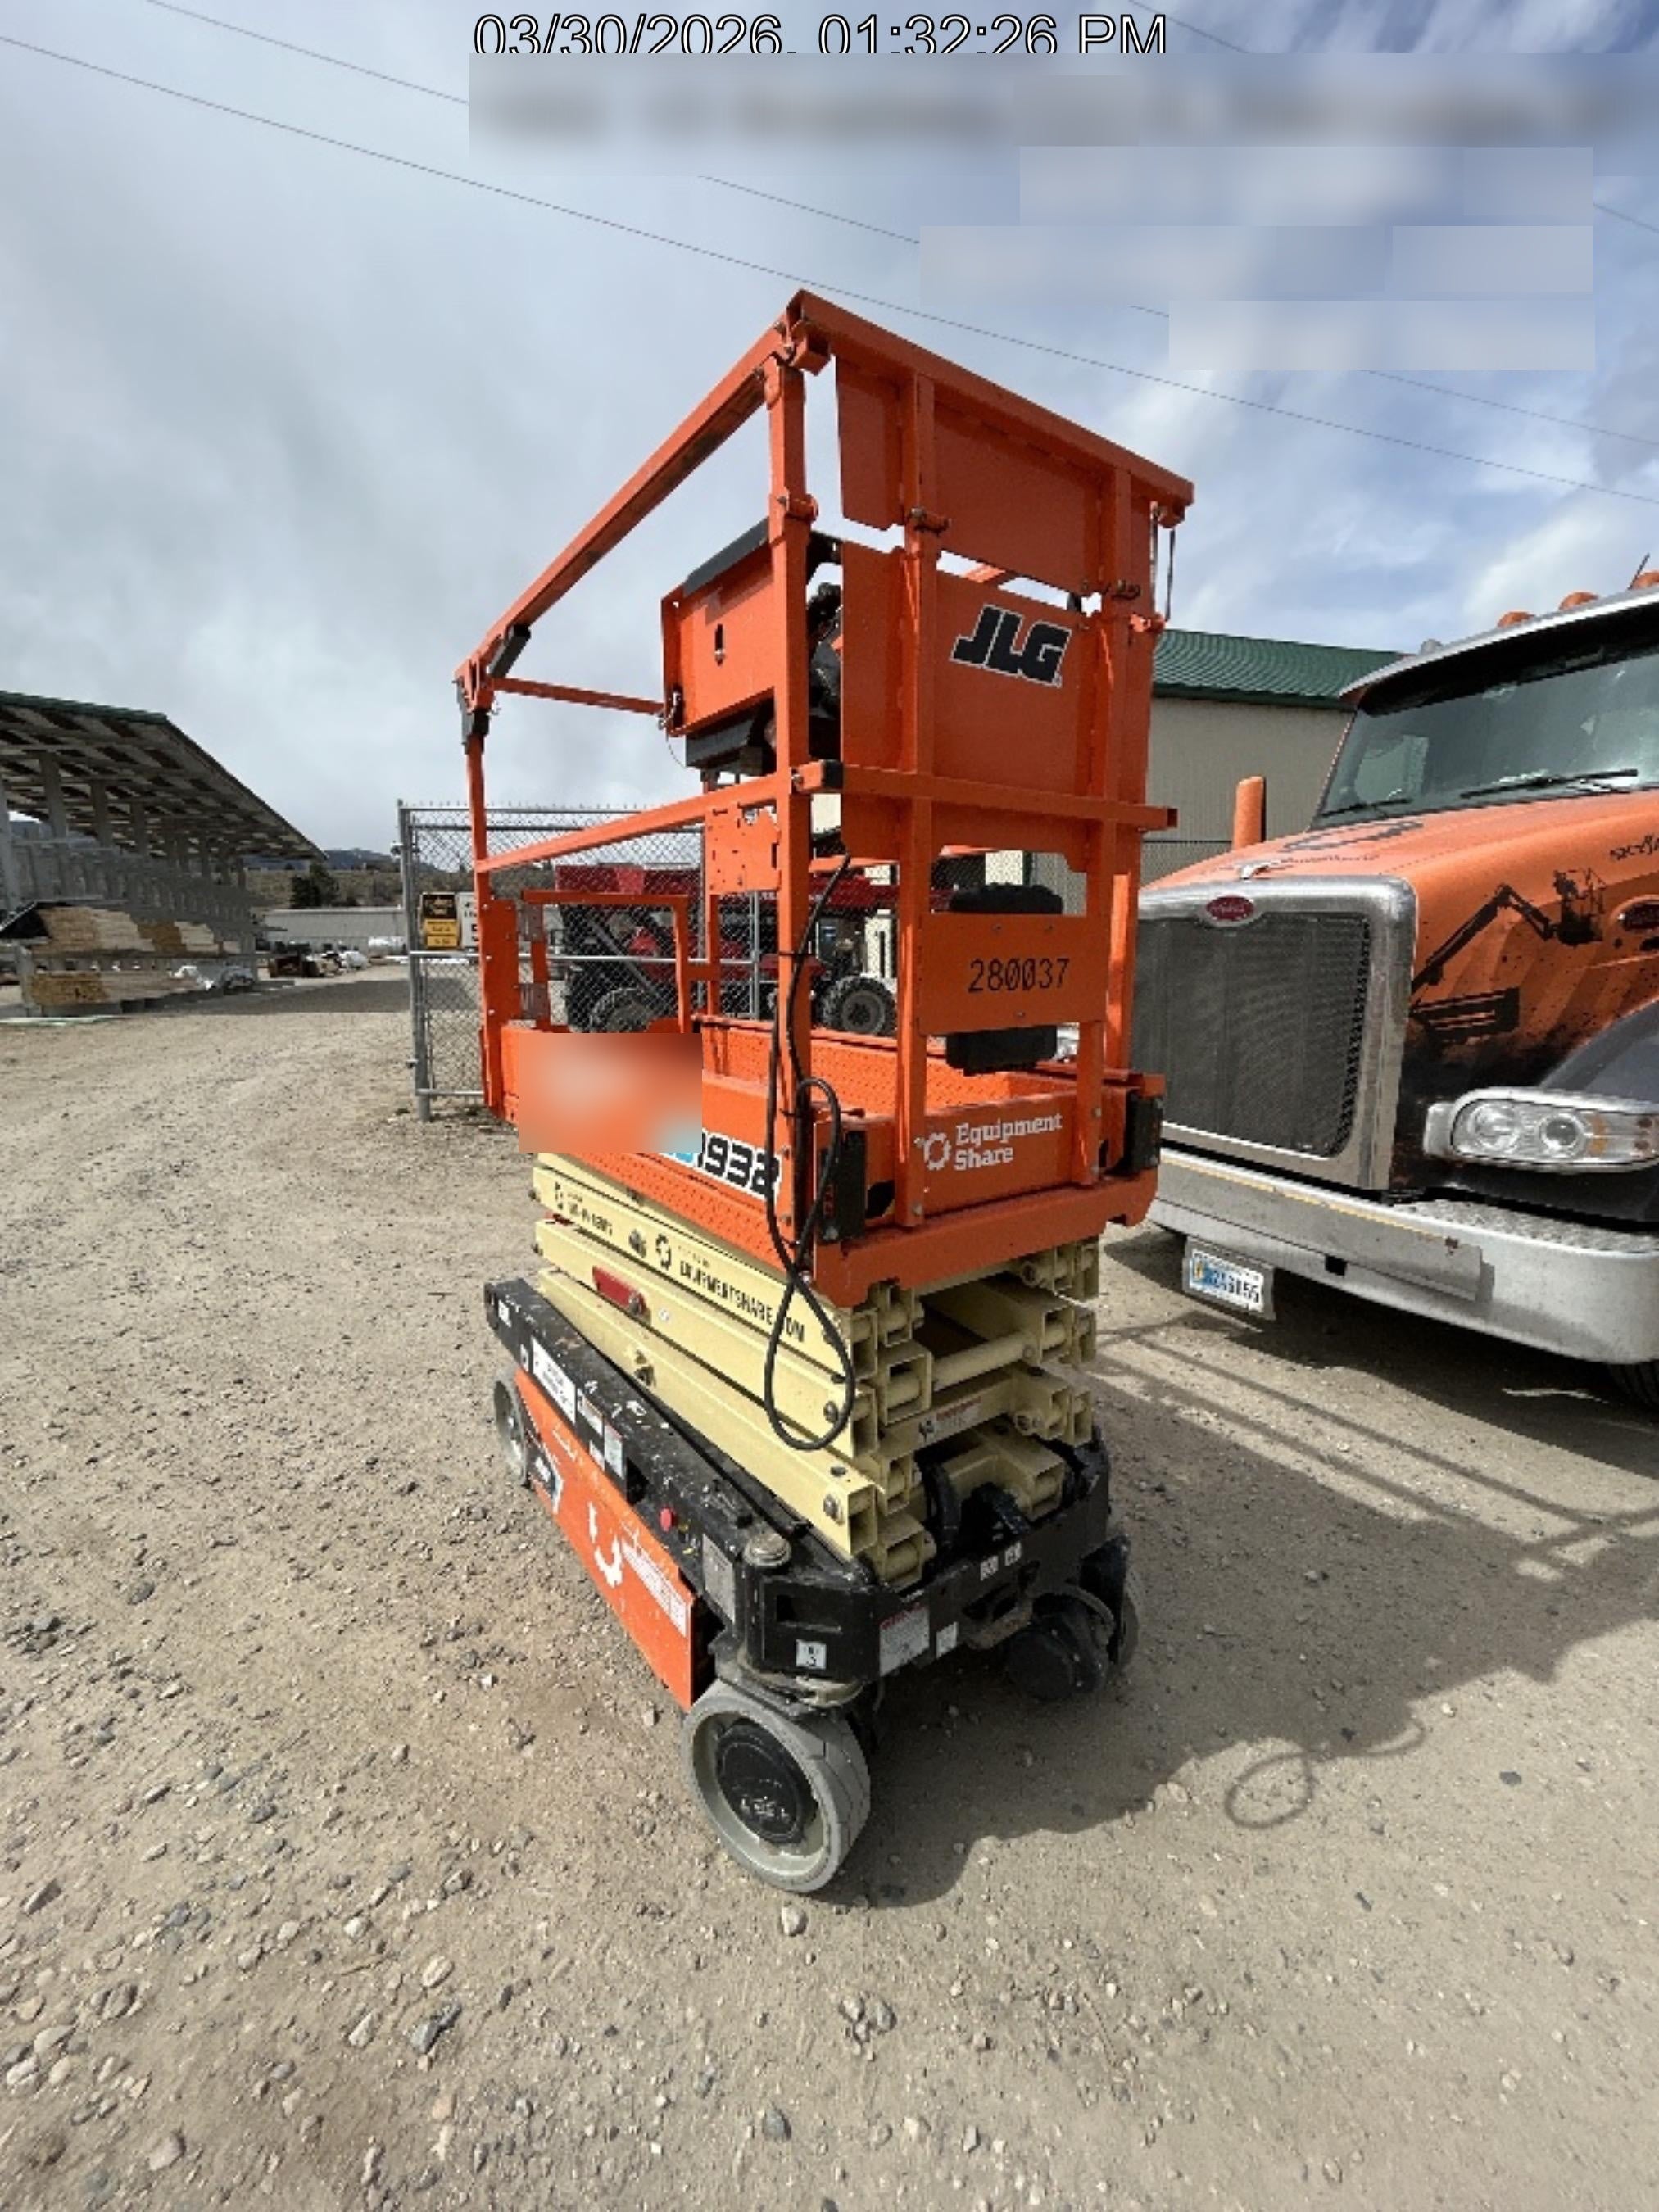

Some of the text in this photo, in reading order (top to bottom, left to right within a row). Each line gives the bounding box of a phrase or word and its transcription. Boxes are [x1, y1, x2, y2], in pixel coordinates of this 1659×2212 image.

[950, 604, 1072, 687] JLG
[968, 958, 1070, 993] 280037
[955, 1113, 1063, 1146] Equipment
[665, 1128, 782, 1199] 1932
[954, 1146, 1014, 1171] Share
